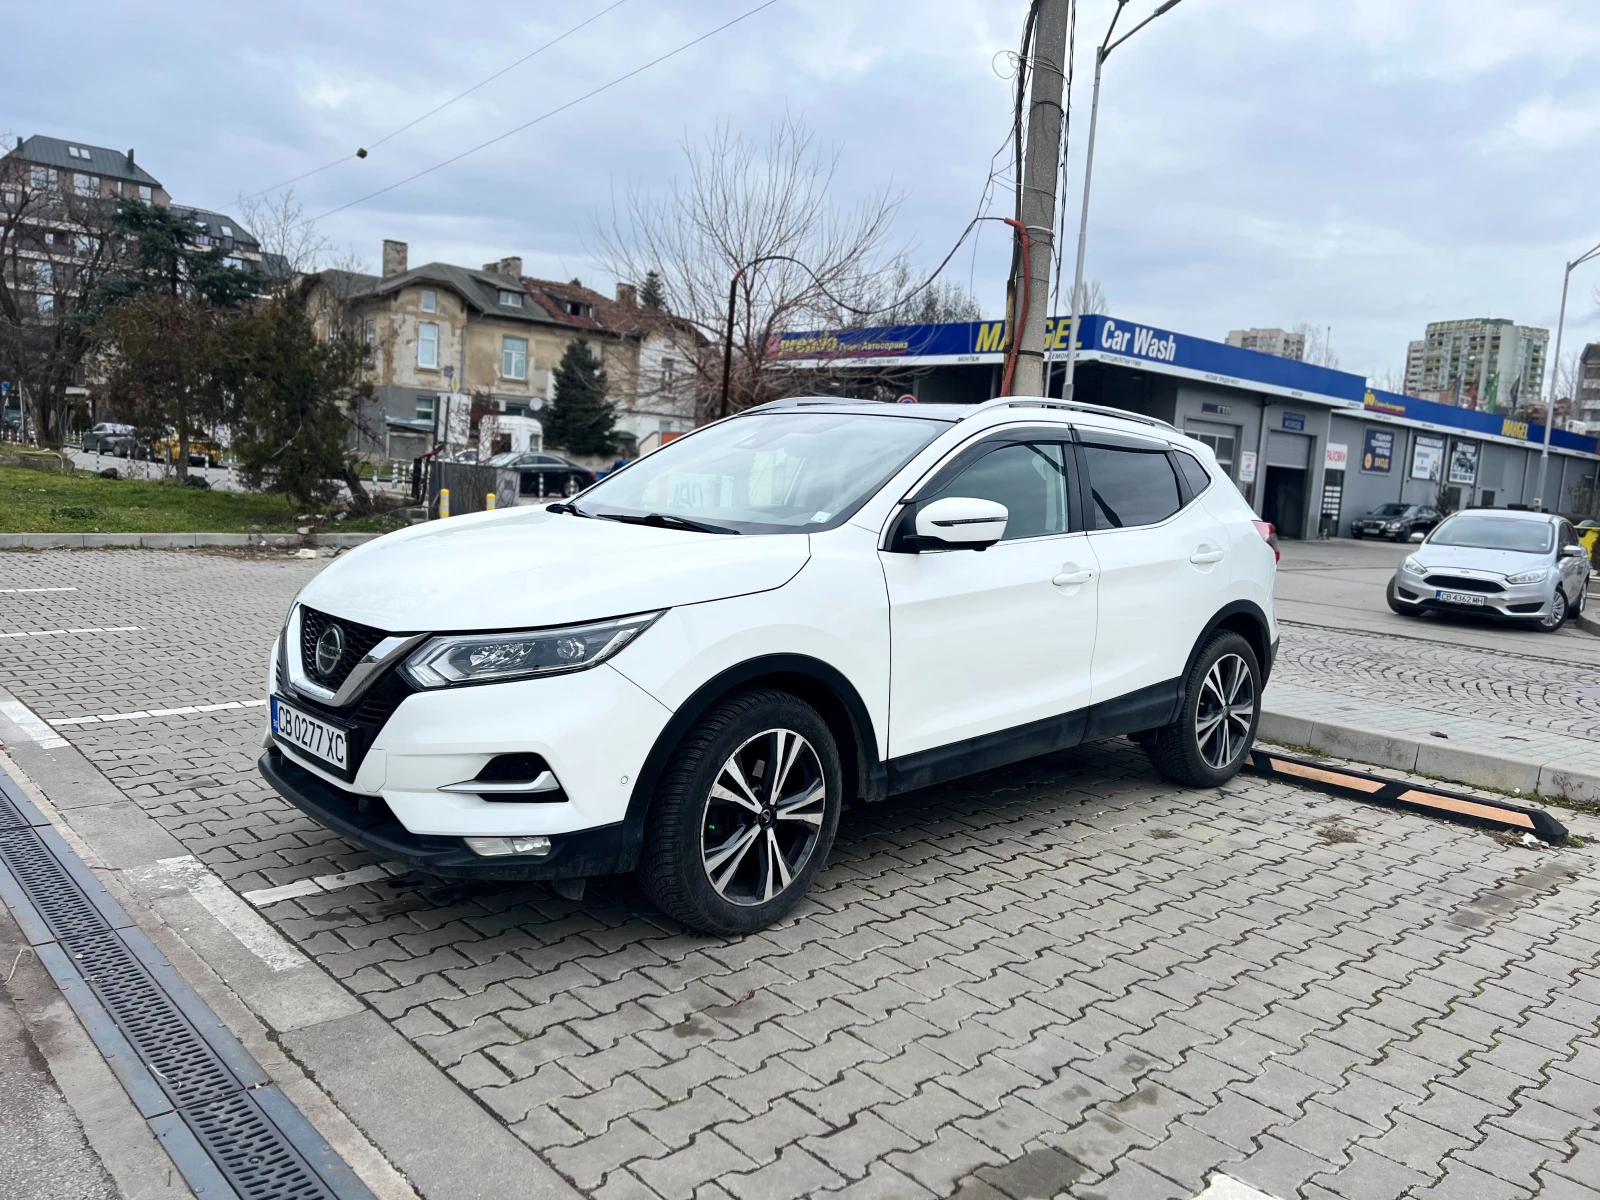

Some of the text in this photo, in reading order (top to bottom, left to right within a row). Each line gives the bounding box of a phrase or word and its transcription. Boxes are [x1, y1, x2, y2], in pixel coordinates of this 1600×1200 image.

[1101, 320, 1177, 362] Car Wash
[278, 705, 344, 763] CB 0277 XC
